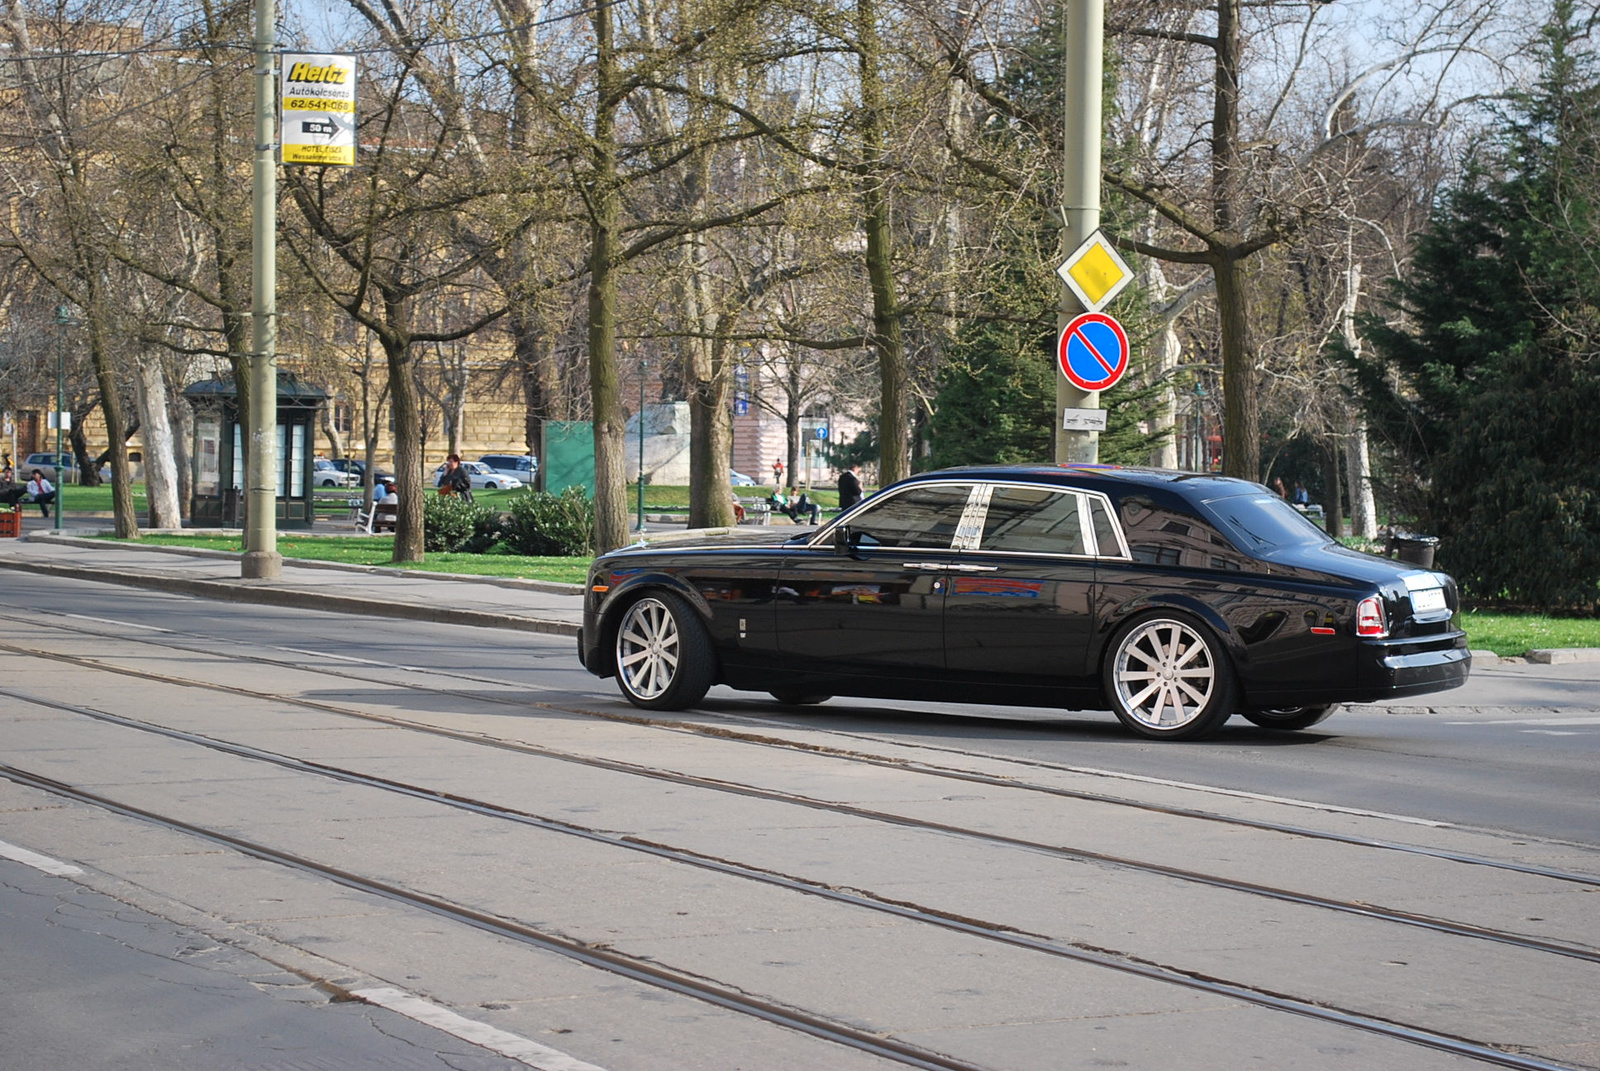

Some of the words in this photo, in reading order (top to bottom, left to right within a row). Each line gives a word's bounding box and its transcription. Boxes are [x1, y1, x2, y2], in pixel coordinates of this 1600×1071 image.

[287, 61, 350, 84] Hertz
[309, 124, 322, 132] 50
[301, 145, 323, 153] HOTEL
